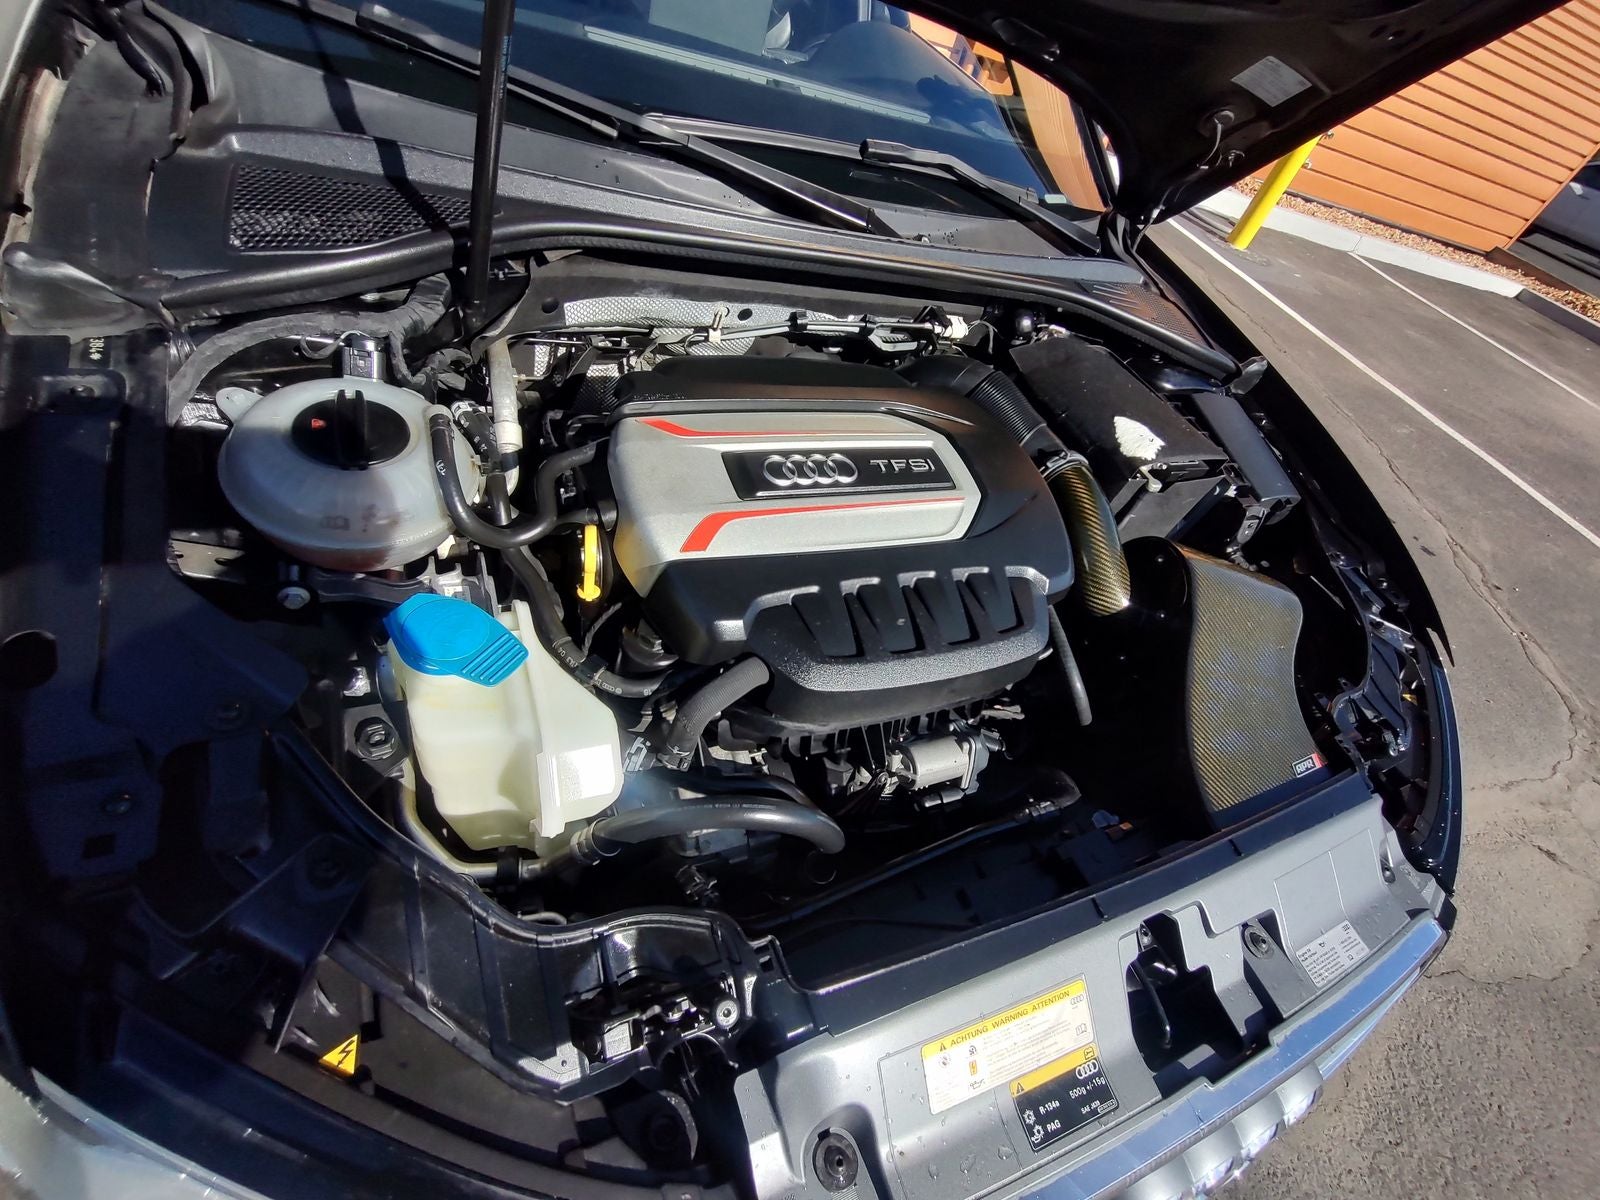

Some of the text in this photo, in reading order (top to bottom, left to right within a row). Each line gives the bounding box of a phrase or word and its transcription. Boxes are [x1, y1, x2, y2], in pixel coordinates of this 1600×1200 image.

[869, 458, 936, 474] TFSI
[1295, 758, 1315, 774] APR
[950, 990, 1070, 1048] ACHTUNG WARNING ATTENTION
[1069, 1086, 1087, 1099] 500g
[1038, 1100, 1060, 1115] R-134a
[1080, 1106, 1091, 1115] SAE
[1046, 1119, 1061, 1133] PAG
